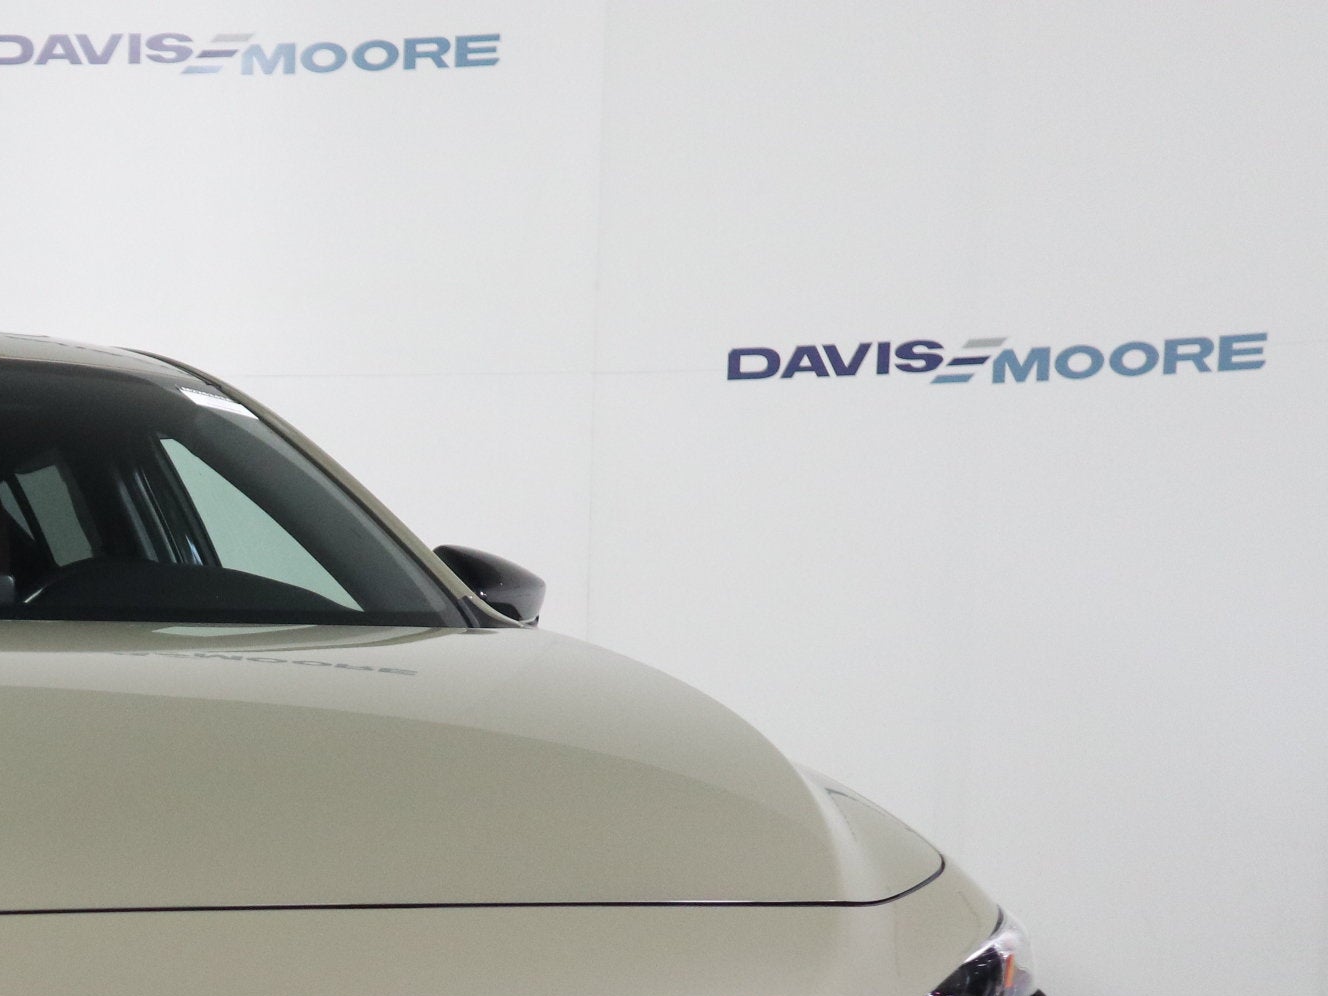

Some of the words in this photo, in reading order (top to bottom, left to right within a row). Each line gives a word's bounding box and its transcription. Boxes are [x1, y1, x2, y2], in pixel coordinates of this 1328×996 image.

[240, 33, 501, 75] MOORE
[726, 339, 944, 381] DAVIS
[991, 332, 1268, 385] MOORE
